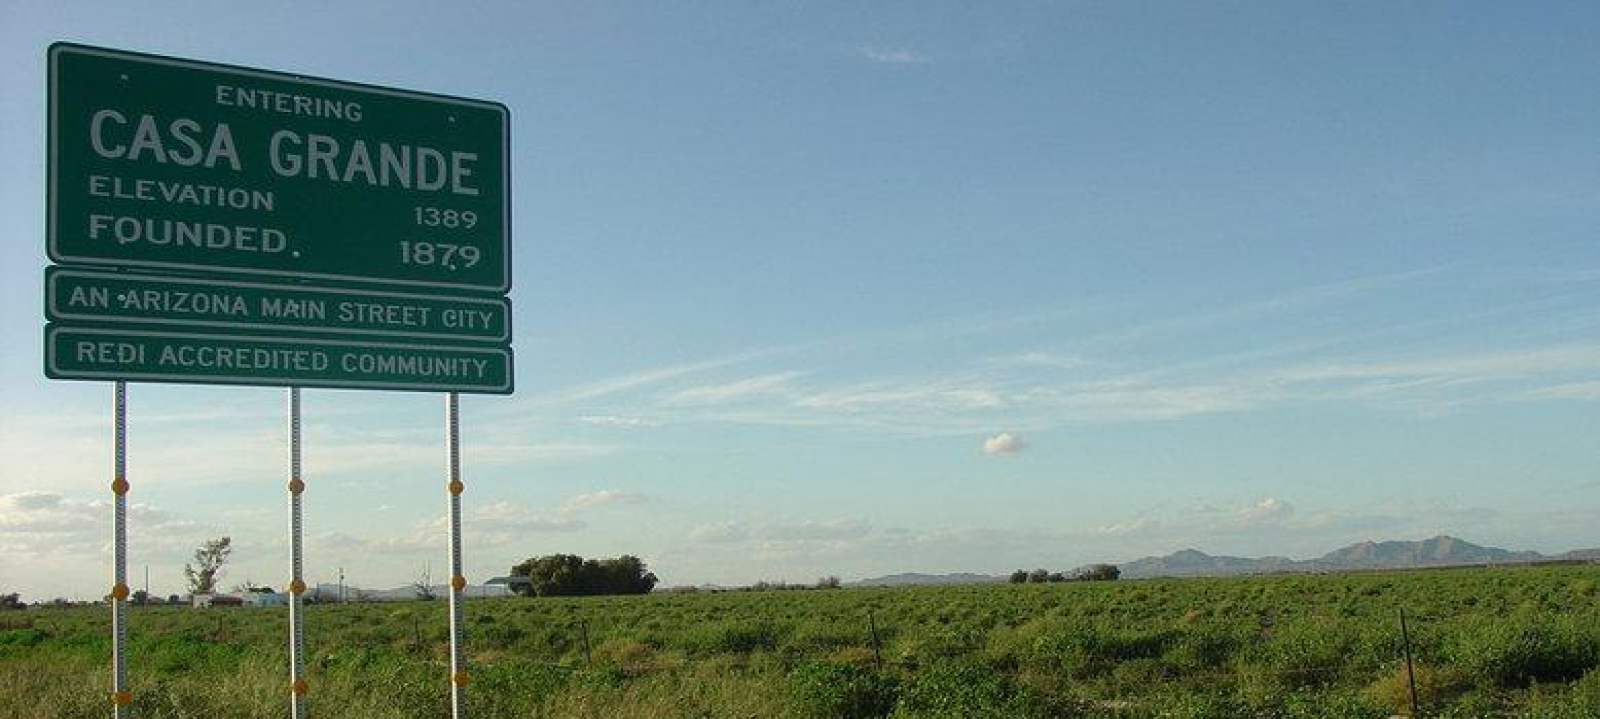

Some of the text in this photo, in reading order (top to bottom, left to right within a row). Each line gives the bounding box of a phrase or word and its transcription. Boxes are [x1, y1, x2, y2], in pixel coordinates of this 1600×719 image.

[216, 85, 363, 122] ENTERING
[89, 109, 479, 195] CASA GRANDE
[89, 175, 478, 228] ELEVATION 1389
[89, 214, 480, 268] FOUNDED 1879
[68, 286, 494, 330] AN ARIZONA MAIN STREET CITY
[76, 340, 488, 378] REDI ACCREDITED COMMUNITY
